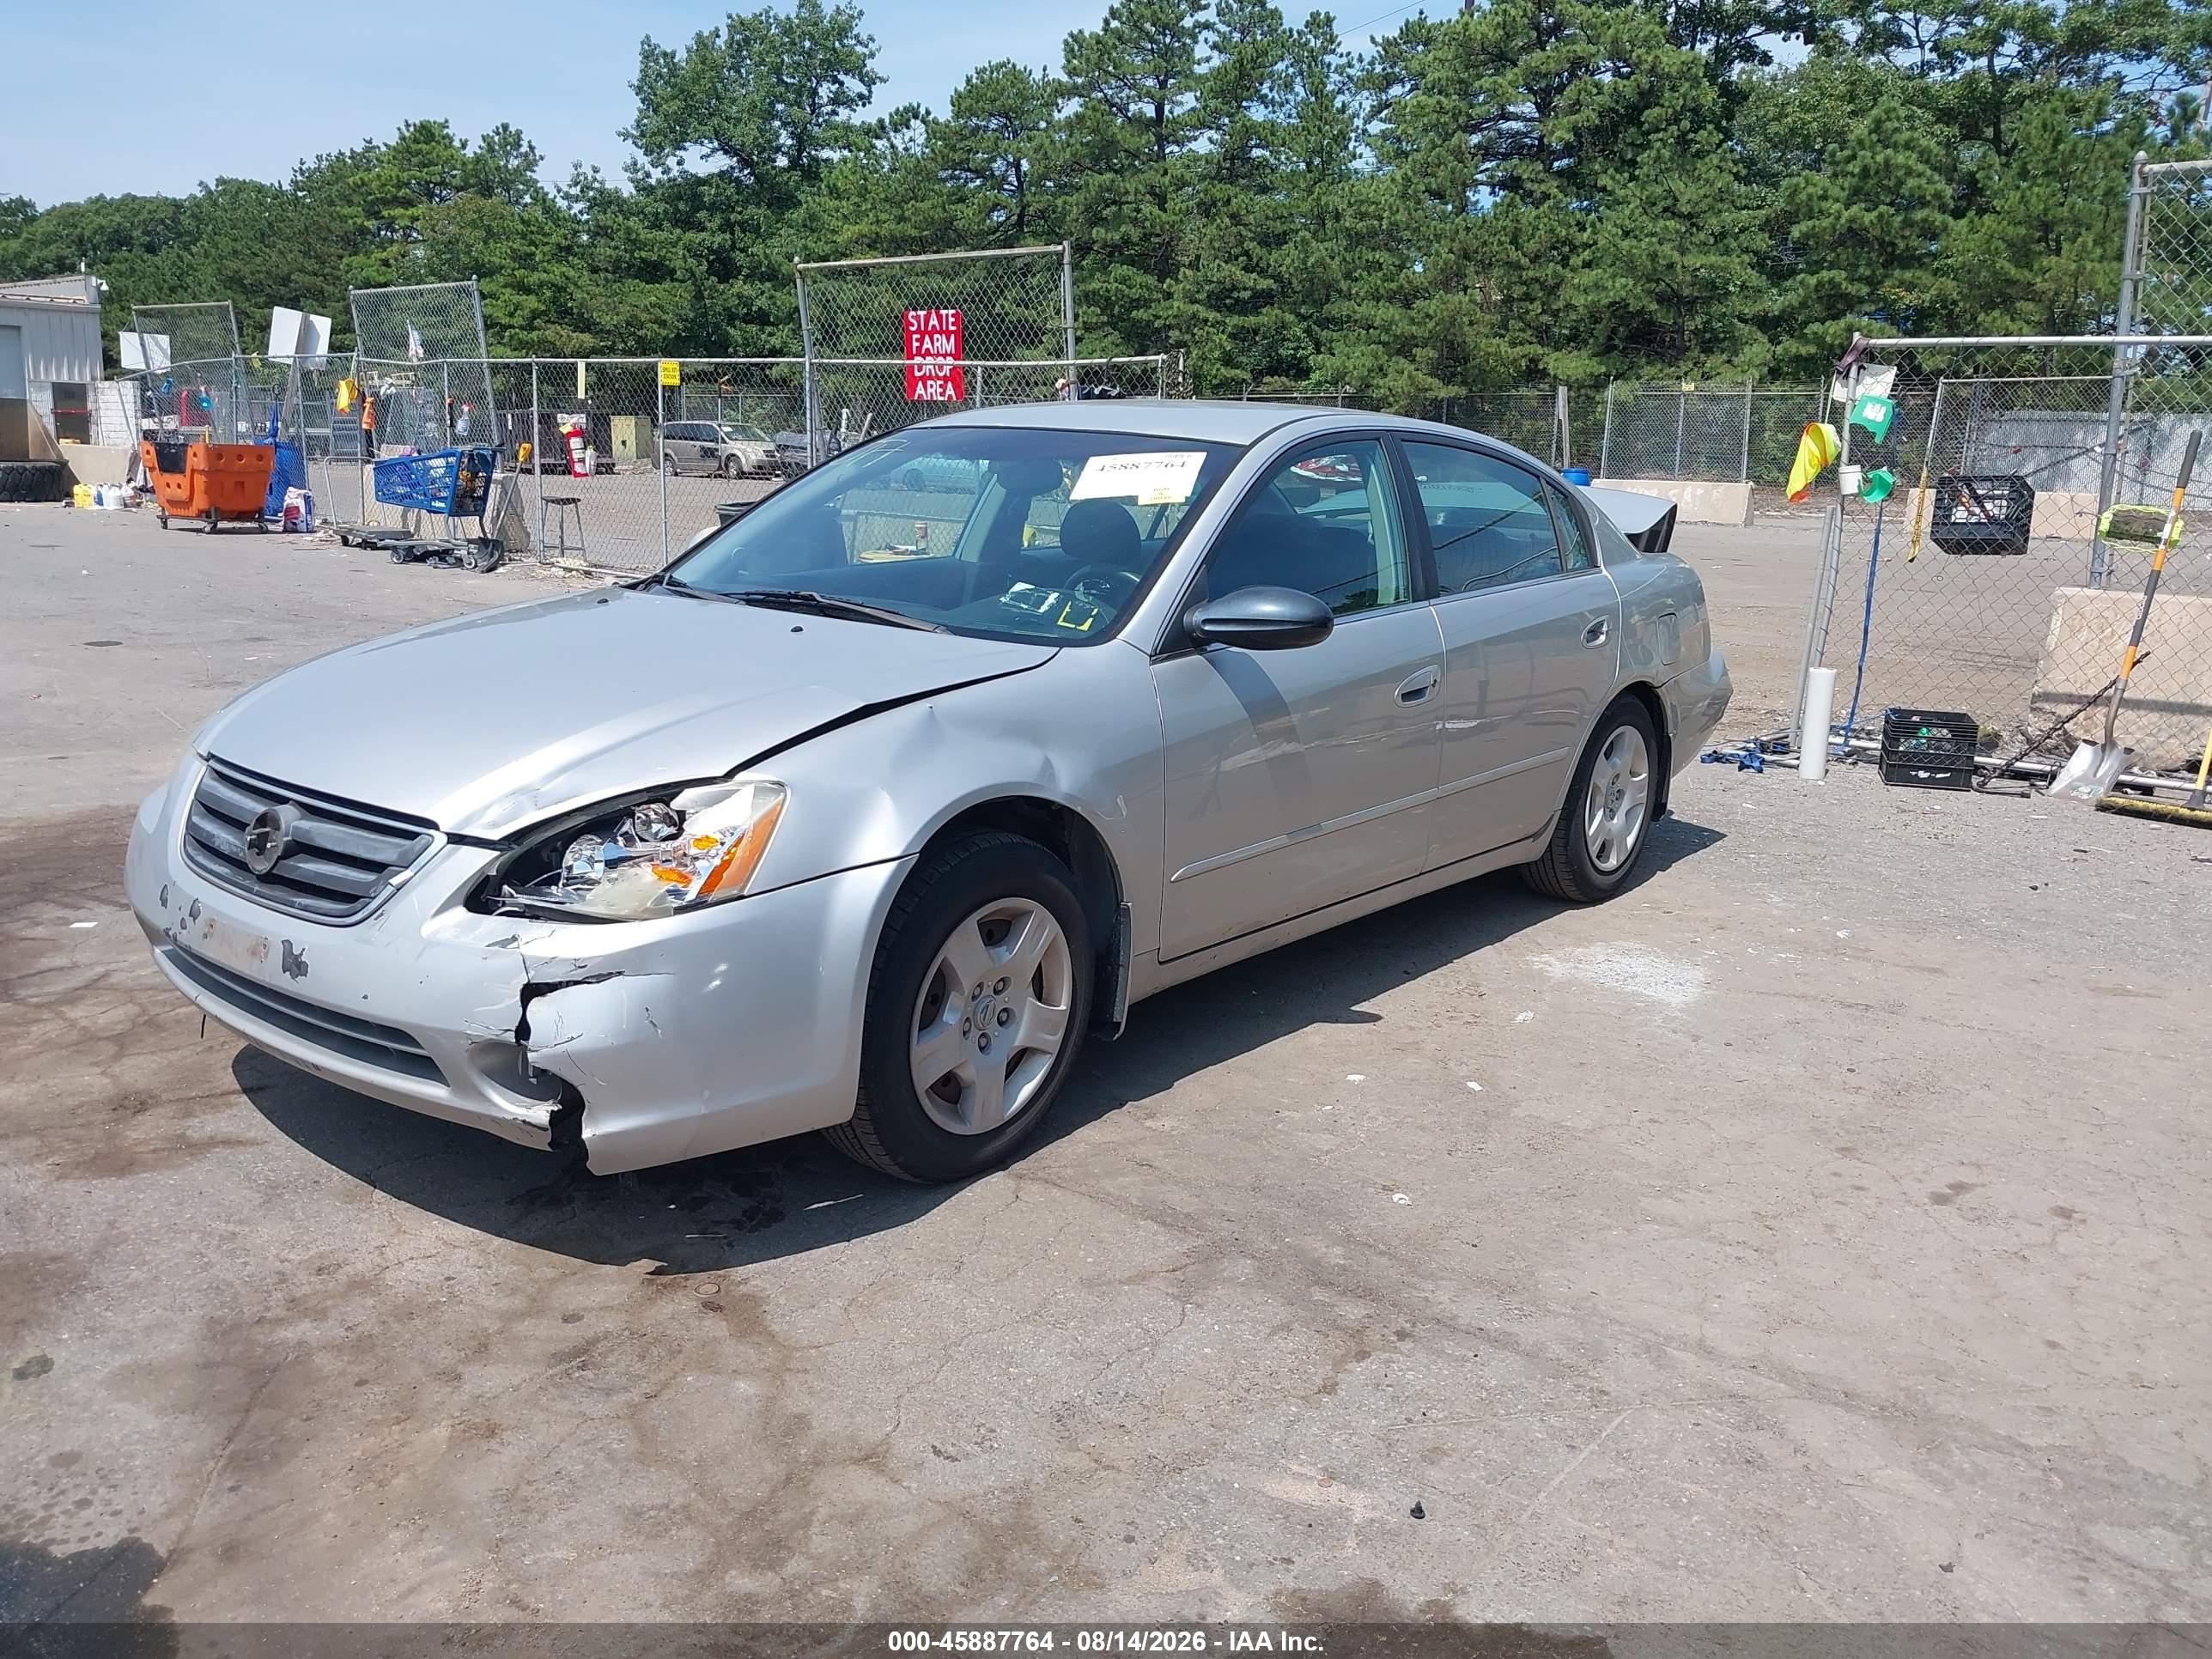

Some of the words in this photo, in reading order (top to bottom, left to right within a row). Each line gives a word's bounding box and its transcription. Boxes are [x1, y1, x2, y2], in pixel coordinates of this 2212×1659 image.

[908, 309, 957, 331] STATE
[912, 333, 955, 354] FARM
[914, 356, 955, 376] DROP
[915, 380, 957, 400] AREA
[1096, 460, 1187, 472] 45887764
